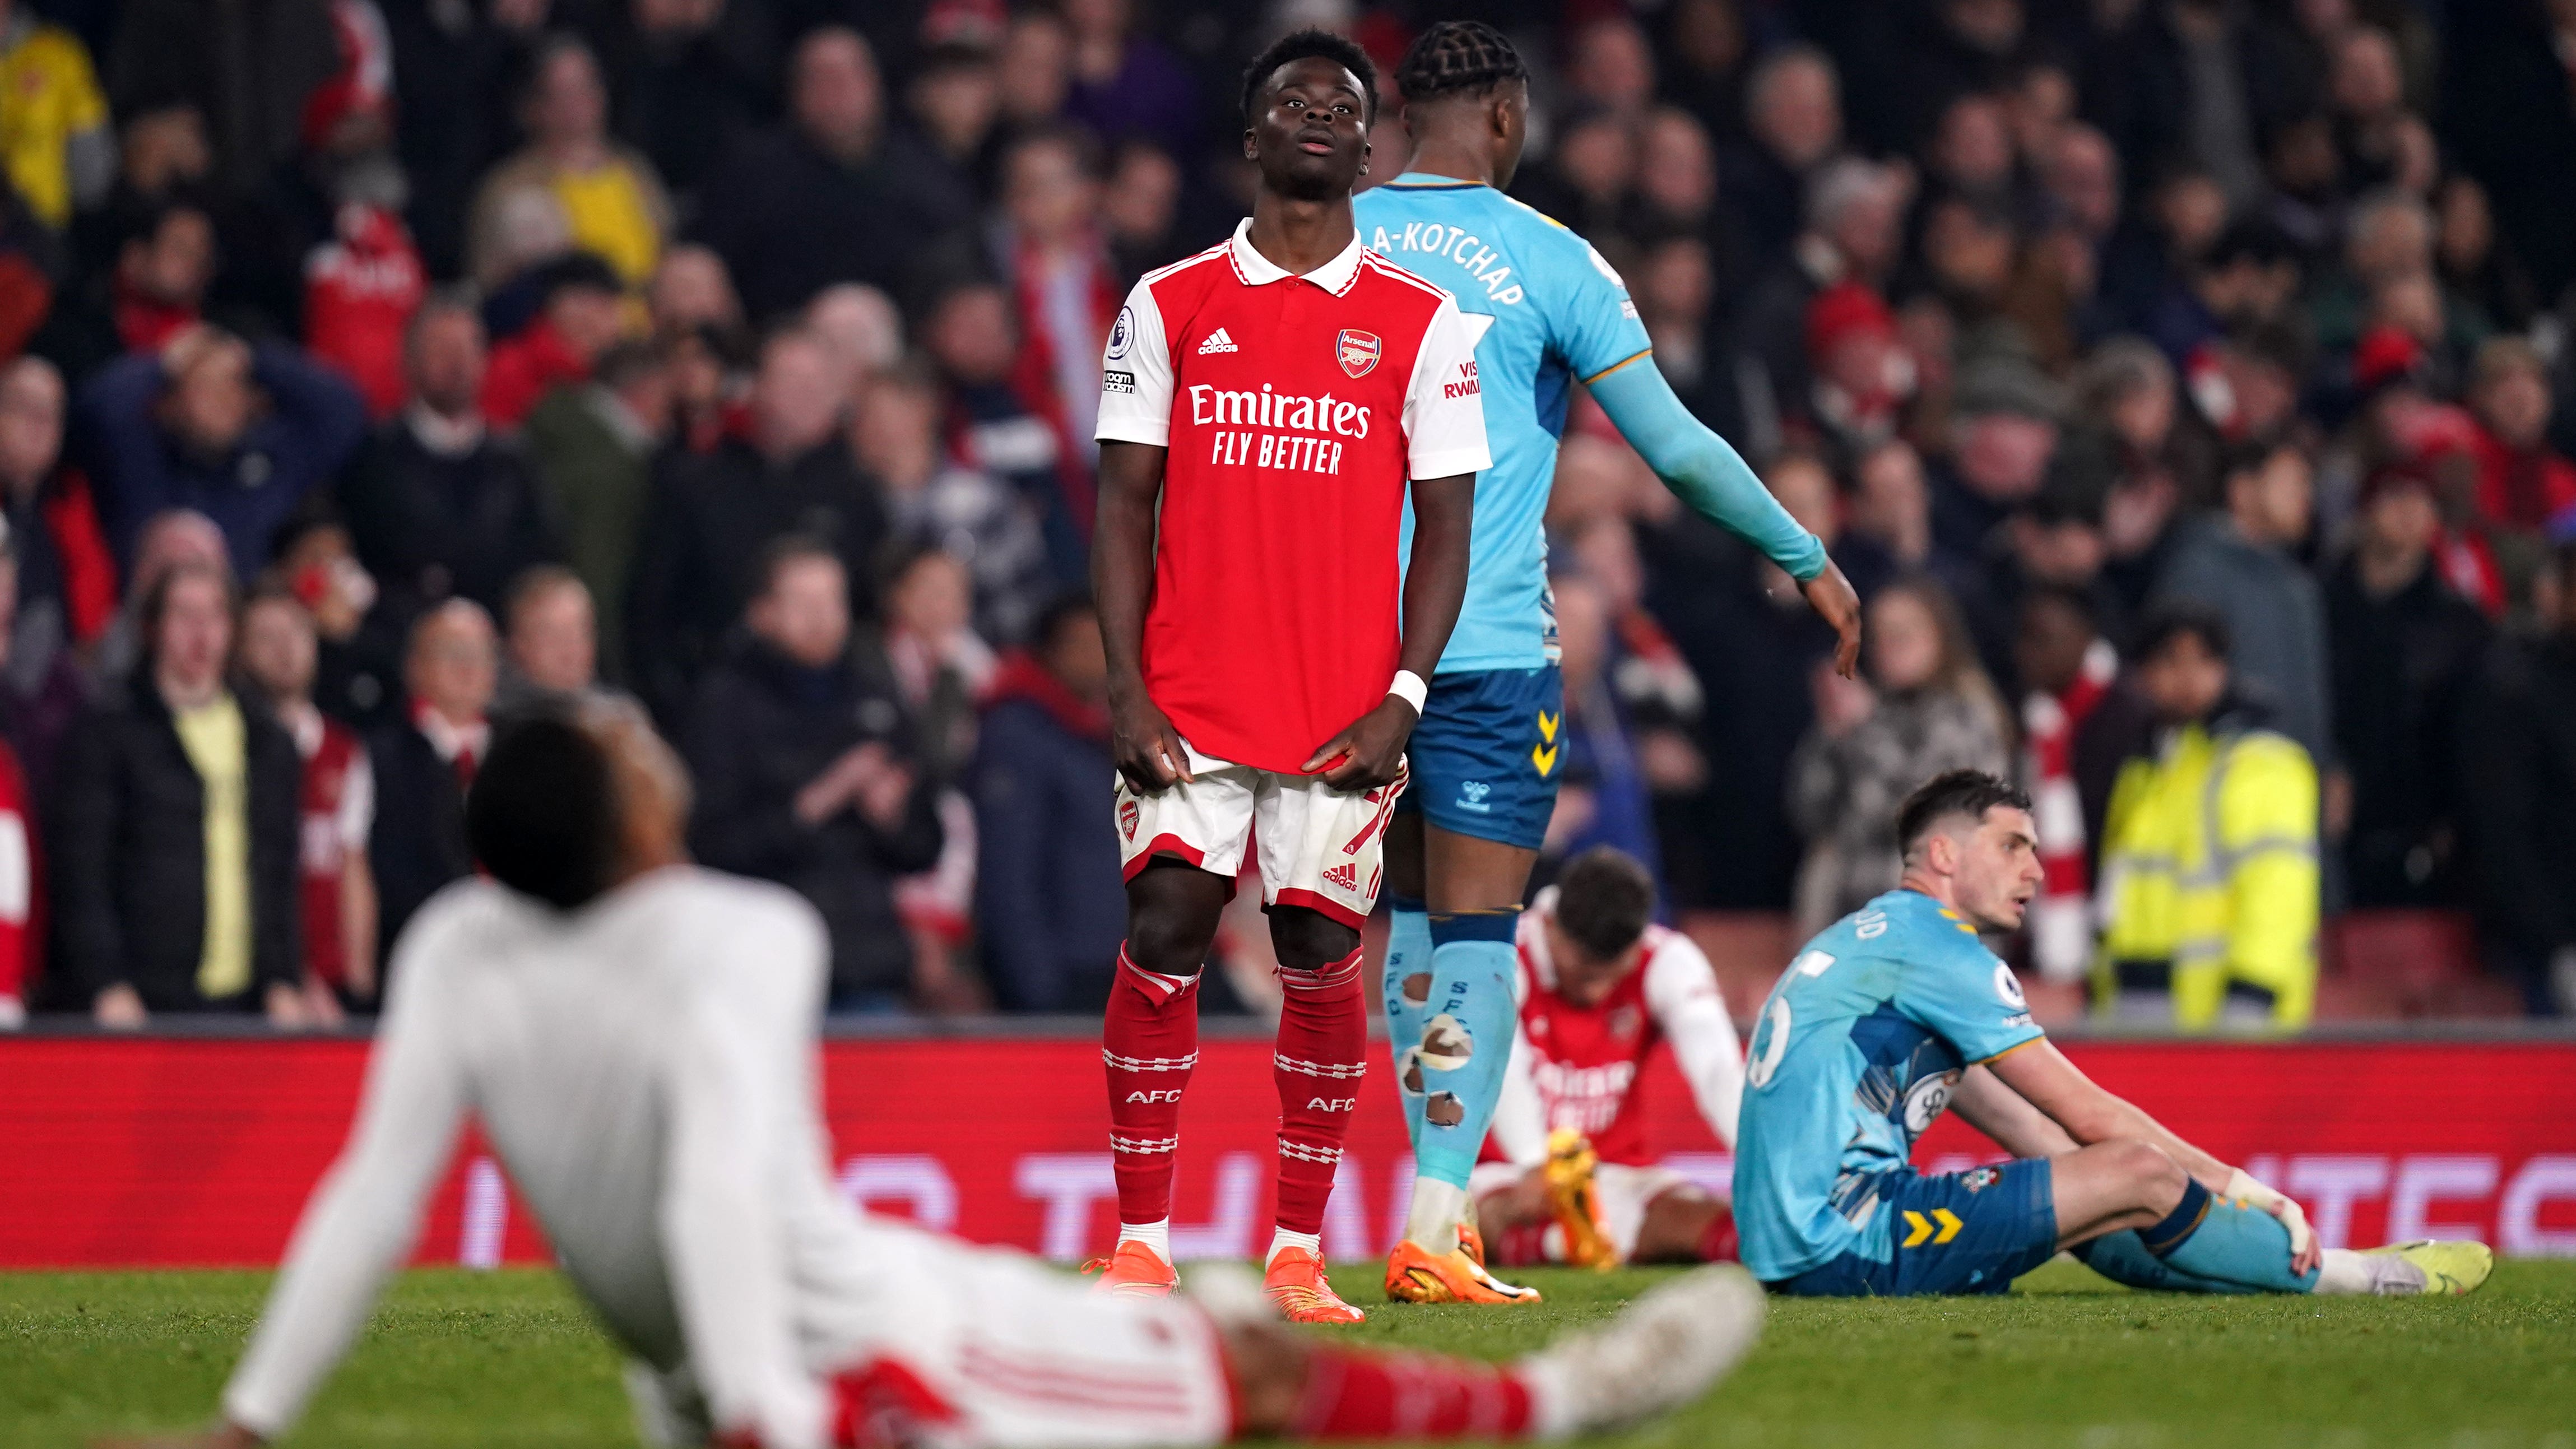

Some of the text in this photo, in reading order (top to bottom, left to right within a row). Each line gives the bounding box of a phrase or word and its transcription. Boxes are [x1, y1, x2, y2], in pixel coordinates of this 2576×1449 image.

[1373, 221, 1524, 305] A-KOTCHAP
[1198, 343, 1238, 355] adidas
[1343, 335, 1376, 349] Arsenal
[1106, 372, 1131, 384] room
[1104, 381, 1135, 394] racism
[1188, 383, 1371, 440] Emirates
[1212, 431, 1343, 476] FLY BETTER
[1322, 870, 1358, 893] adidas
[1125, 1089, 1183, 1104] AFC
[1306, 1097, 1356, 1113] AFC
